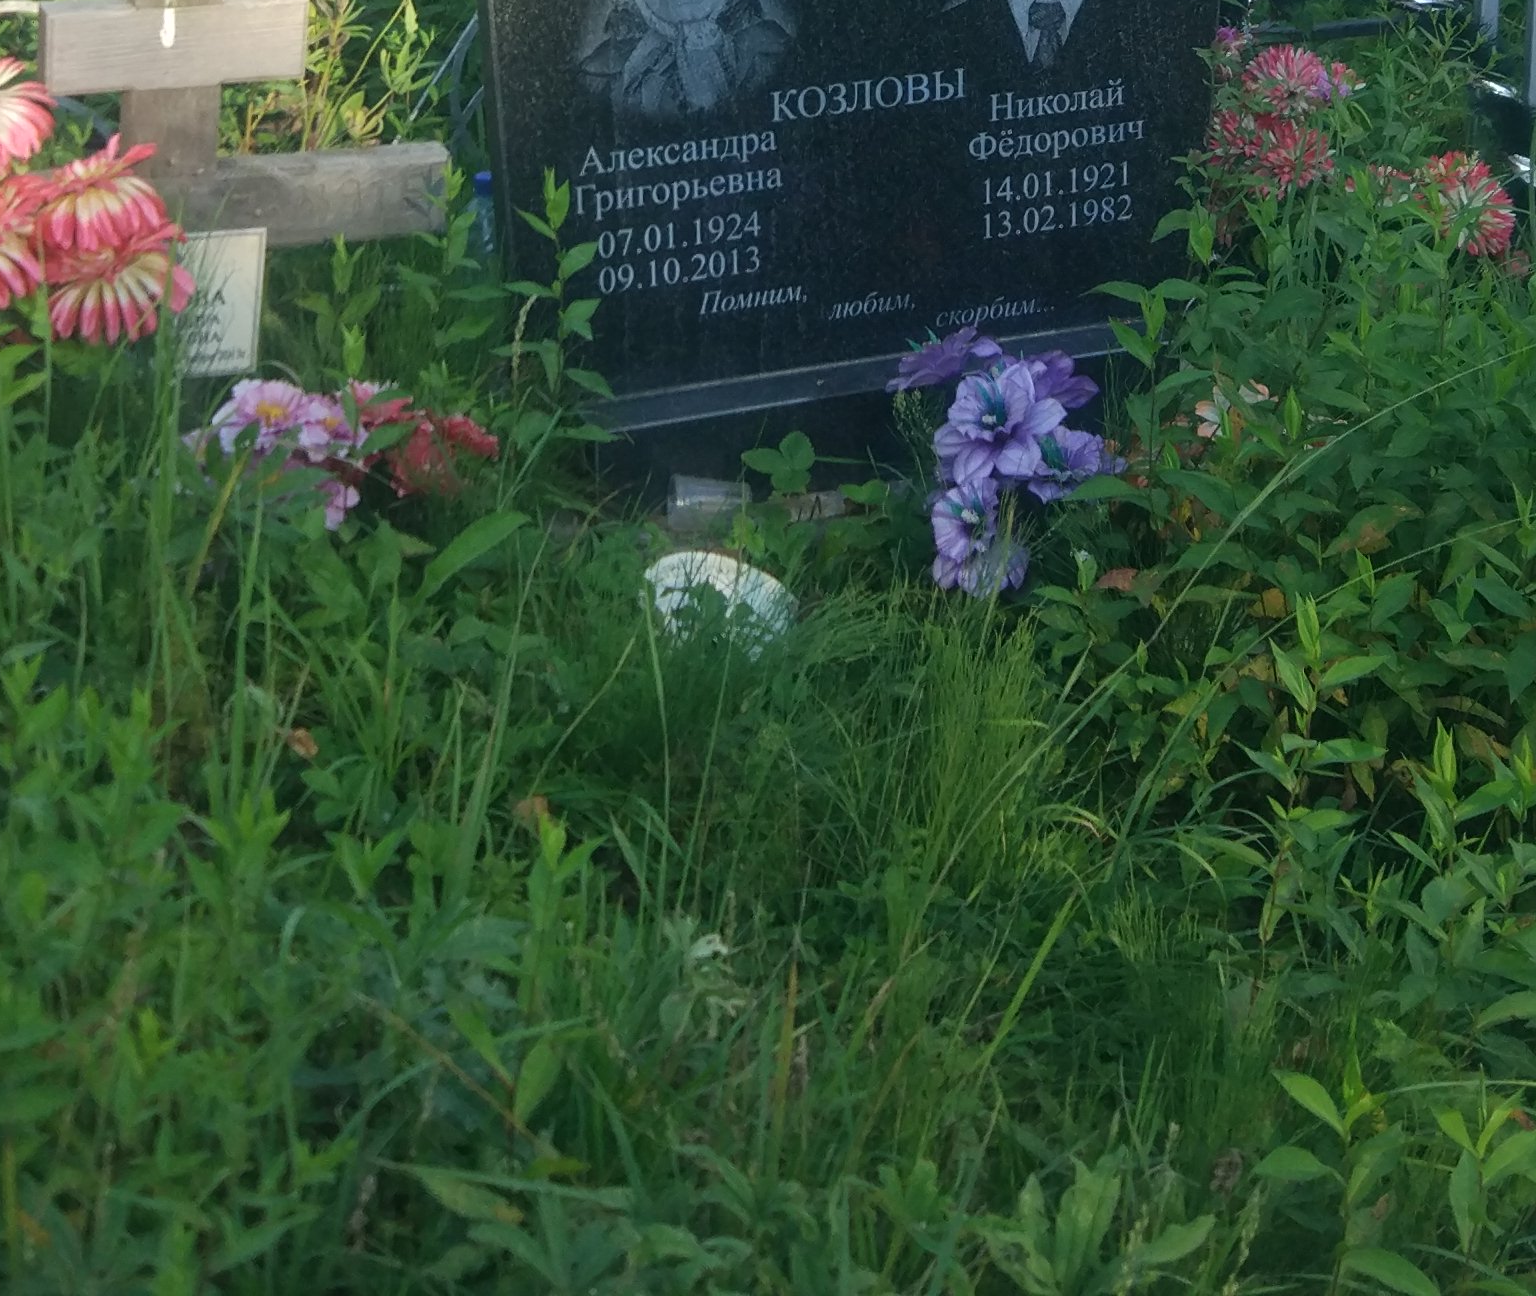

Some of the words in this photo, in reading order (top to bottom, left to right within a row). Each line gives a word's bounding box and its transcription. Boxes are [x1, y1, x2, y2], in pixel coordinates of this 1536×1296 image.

[770, 68, 966, 122] КОЗЛОВЫ
[989, 78, 1125, 122] Николай
[579, 130, 777, 176] Александра
[968, 119, 1146, 161] Фёдорович
[574, 167, 783, 221] Григорьевна
[984, 161, 1129, 204] 14.01.1921
[598, 211, 761, 258] 07.01.1924
[984, 194, 1133, 239] 13.02.1982
[599, 246, 761, 294] 09.10.2013
[699, 285, 807, 315] Помним,
[828, 291, 915, 320] любим,
[936, 295, 1055, 328] скорбим...
